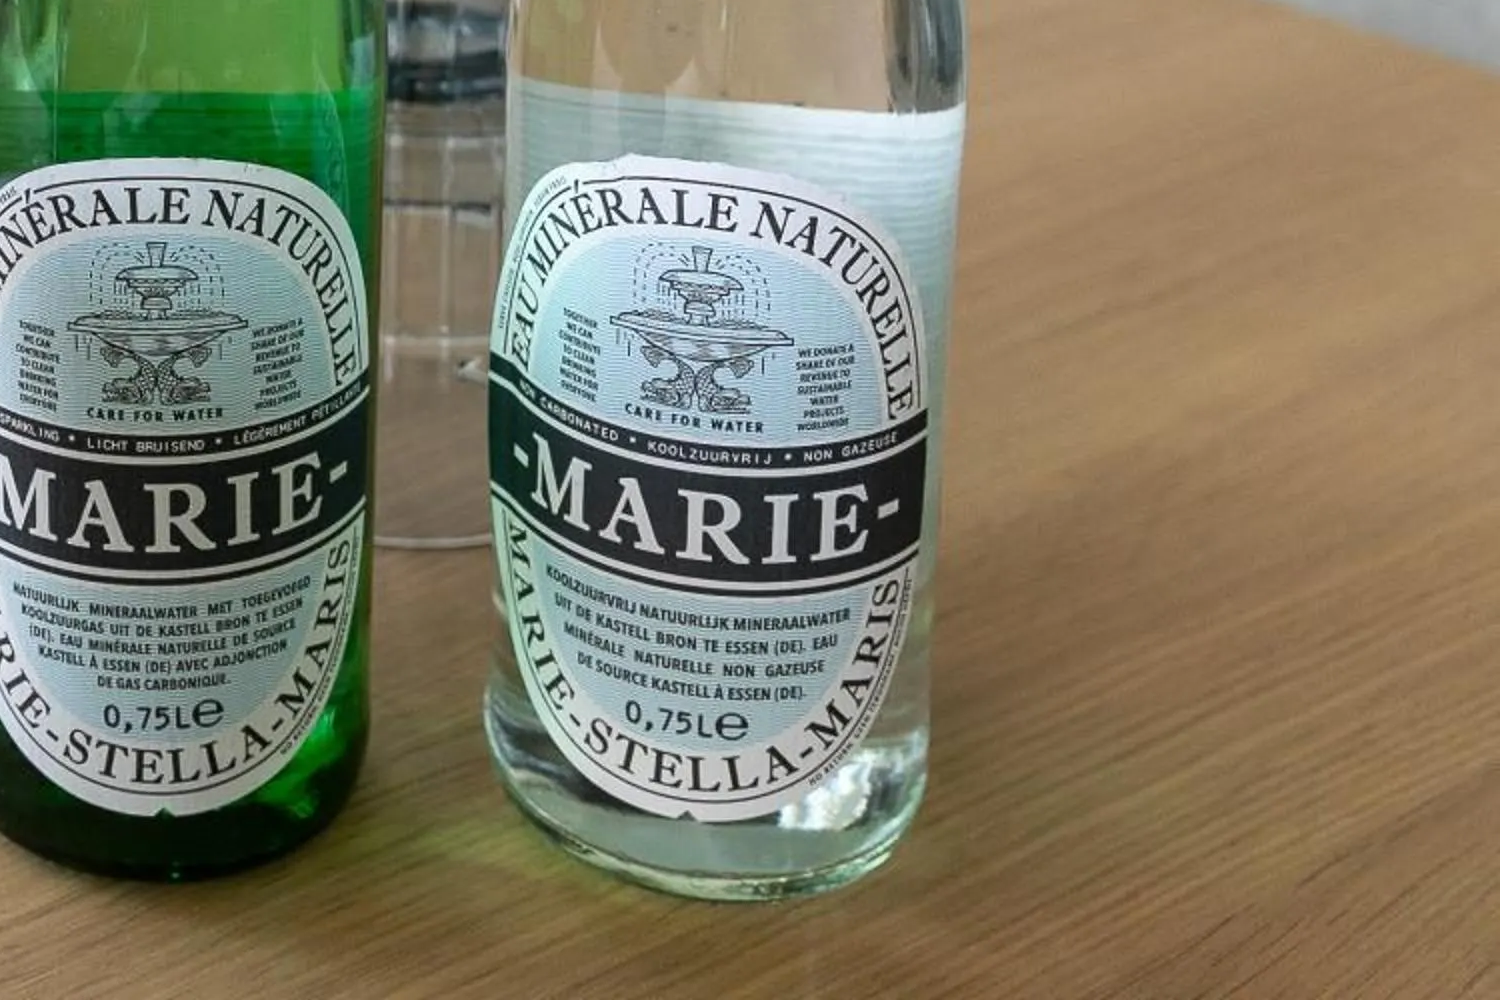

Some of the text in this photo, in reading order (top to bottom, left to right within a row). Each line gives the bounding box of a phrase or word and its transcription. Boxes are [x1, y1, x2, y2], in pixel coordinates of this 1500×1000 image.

[201, 189, 359, 387] NATURELLE
[511, 273, 539, 369] EAU
[526, 179, 739, 288] MINÉRALE
[750, 200, 916, 421] NATURELLE
[86, 407, 223, 423] CARE FOR WATER
[519, 379, 899, 465] NON CARBONATED KOOLZUURVRIJ NON GAZEUSE
[624, 403, 765, 434] CARE FOR WATER
[87, 437, 129, 453] LICHT
[136, 439, 206, 453] BRUISEND
[13, 575, 311, 620] NATUURLIJK MINERAALWATER MET TOEGEVOEGD
[21, 597, 304, 638] KOOLZUURGAS UIT DE KASTELL BRON TE ESSEN
[545, 564, 850, 631] KOOLZUURVRIJ NATUURLIJK MINERAALWATER
[59, 633, 83, 649] EAU
[88, 637, 150, 656] MINÉRALE
[157, 637, 227, 655] NATURELLE
[233, 632, 249, 647] DE
[253, 617, 297, 642] SOURCE
[555, 591, 573, 612] UIT
[576, 604, 592, 622] DE
[595, 612, 650, 642] KASTELL
[655, 631, 697, 650] BRON
[703, 639, 719, 653] TE
[725, 640, 769, 655] ESSEN
[812, 633, 838, 650] EAU
[38, 643, 85, 667] KASTELL
[103, 658, 141, 673] ESSEN
[145, 660, 171, 675] (DE)
[176, 657, 209, 673] AVEC
[213, 638, 288, 668] ADJONCTION
[563, 621, 826, 677] MINÉRALE NATURELLE NON GAZEUSE
[97, 675, 113, 689] DE
[115, 676, 141, 691] GAS
[577, 651, 594, 669] DE
[595, 659, 648, 687] SOURCE
[651, 676, 711, 699] KASTELL
[728, 687, 771, 701] ESSEN
